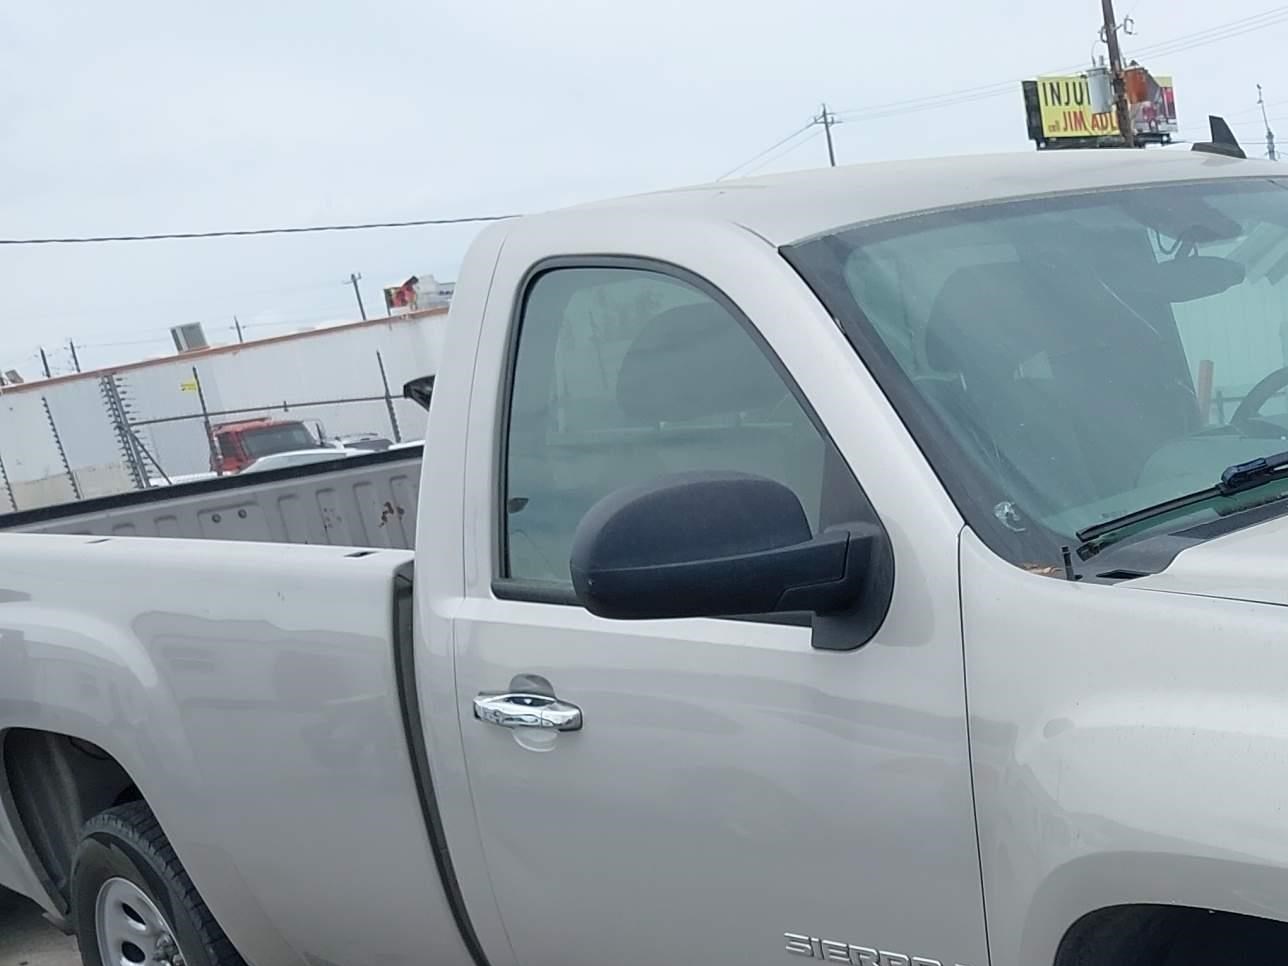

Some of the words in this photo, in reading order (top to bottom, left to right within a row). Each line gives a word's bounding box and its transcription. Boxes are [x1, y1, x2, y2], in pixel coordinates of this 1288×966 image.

[1042, 82, 1091, 106] INJU
[1062, 110, 1087, 131] JIM
[1091, 113, 1119, 131] ADL
